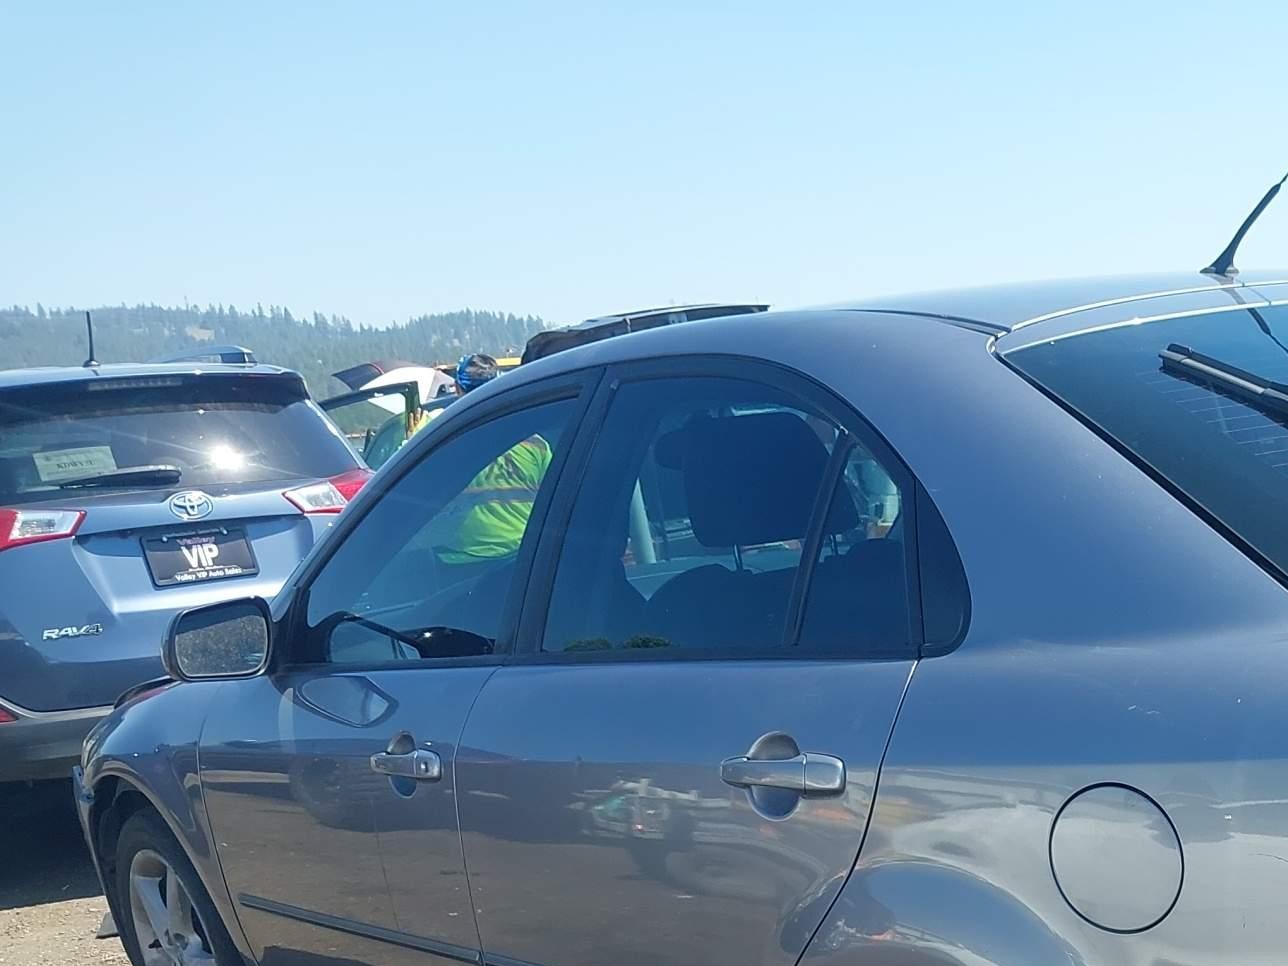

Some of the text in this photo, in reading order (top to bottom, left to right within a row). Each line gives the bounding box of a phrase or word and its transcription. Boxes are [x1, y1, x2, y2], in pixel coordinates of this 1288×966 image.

[181, 543, 219, 568] VIP
[209, 569, 224, 577] Auto
[42, 623, 104, 640] RAV4
